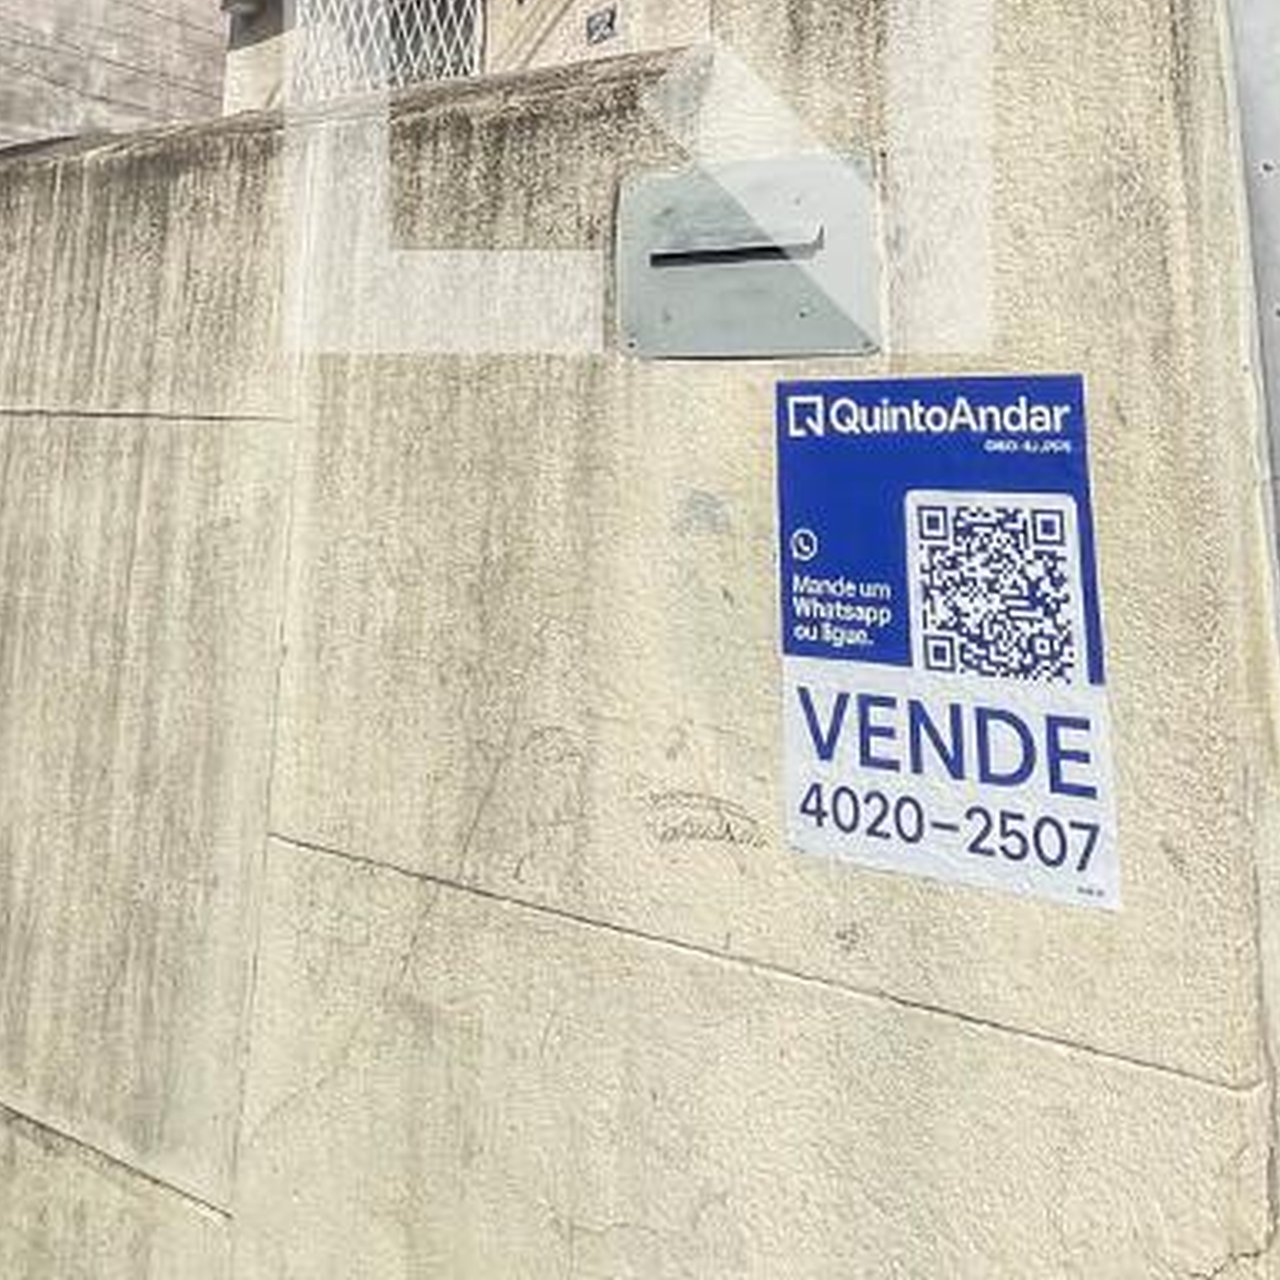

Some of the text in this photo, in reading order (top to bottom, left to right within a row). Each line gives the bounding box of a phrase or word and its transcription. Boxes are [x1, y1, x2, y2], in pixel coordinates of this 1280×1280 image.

[829, 394, 1072, 435] QuintoAndar
[859, 581, 891, 600] um
[793, 623, 819, 642] ou
[797, 684, 1098, 801] VENDE
[799, 782, 1101, 873] 4020-2507
